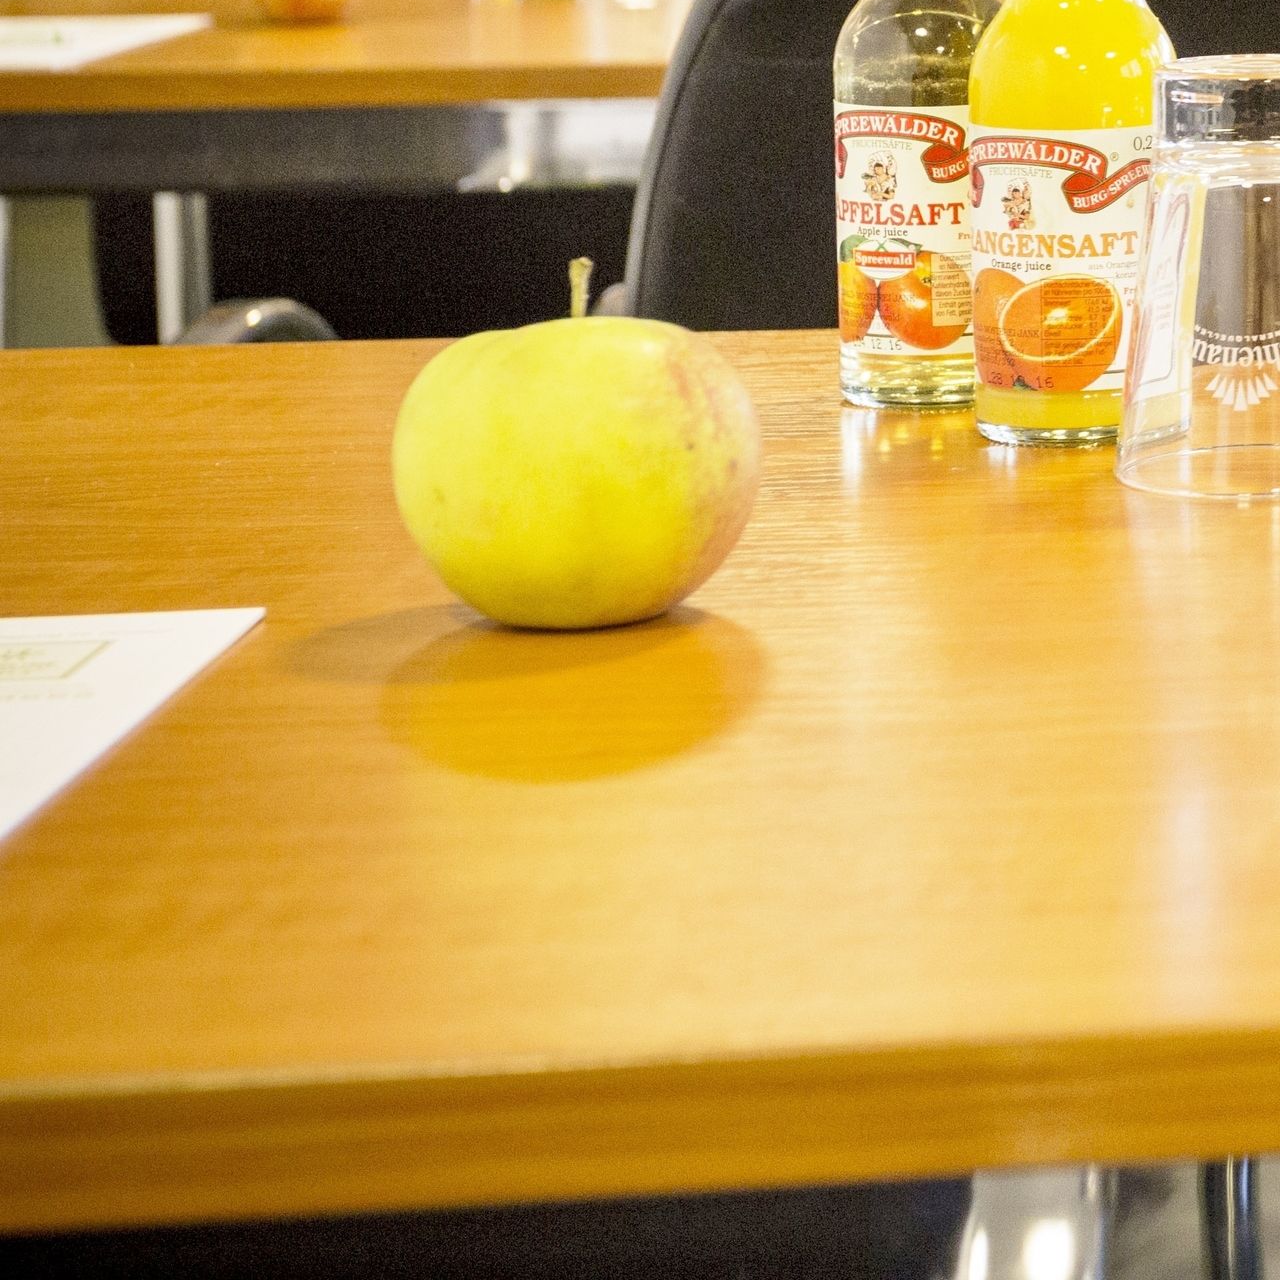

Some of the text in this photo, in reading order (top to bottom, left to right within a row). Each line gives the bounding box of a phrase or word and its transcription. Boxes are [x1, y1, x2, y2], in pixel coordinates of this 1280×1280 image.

[989, 166, 1053, 179] FRUCHTSÄFTE
[857, 226, 909, 238] Apple juice
[855, 253, 913, 266] Spreewald
[991, 258, 1052, 272] Orange juice
